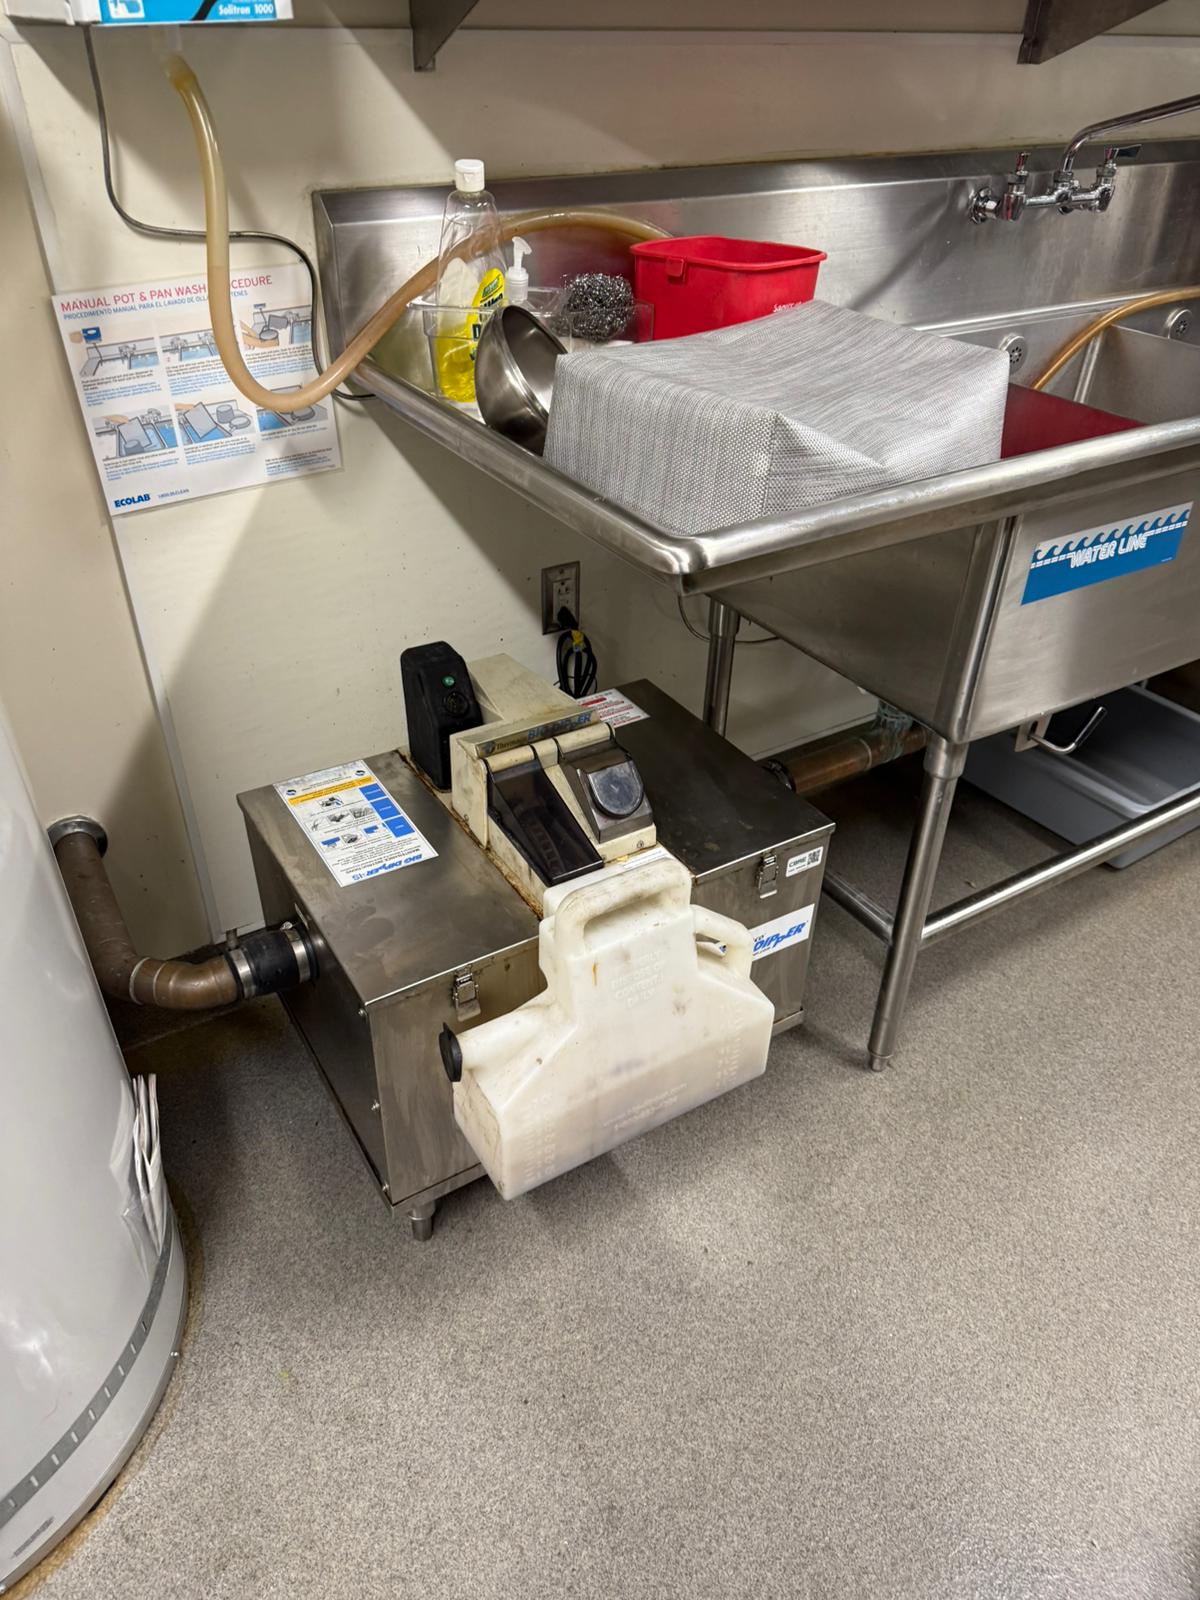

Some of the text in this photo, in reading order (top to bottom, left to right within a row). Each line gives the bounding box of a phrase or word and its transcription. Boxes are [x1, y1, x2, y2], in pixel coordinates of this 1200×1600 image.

[219, 3, 274, 15] Solitron 1000
[61, 296, 111, 312] MANUAL
[113, 293, 136, 306] POT
[139, 291, 147, 302] &
[149, 288, 173, 300] PAN
[175, 284, 207, 297] WASH
[63, 307, 112, 321] PROCEDIMIENTO
[113, 304, 138, 315] MANUAL
[138, 302, 154, 311] PARA
[164, 297, 186, 307] LAVADO
[187, 296, 195, 304] DE
[114, 493, 151, 508] ECOLAB
[1070, 533, 1147, 569] WATER LINE
[403, 854, 423, 865] BIG
[752, 921, 807, 953] DIPPER
